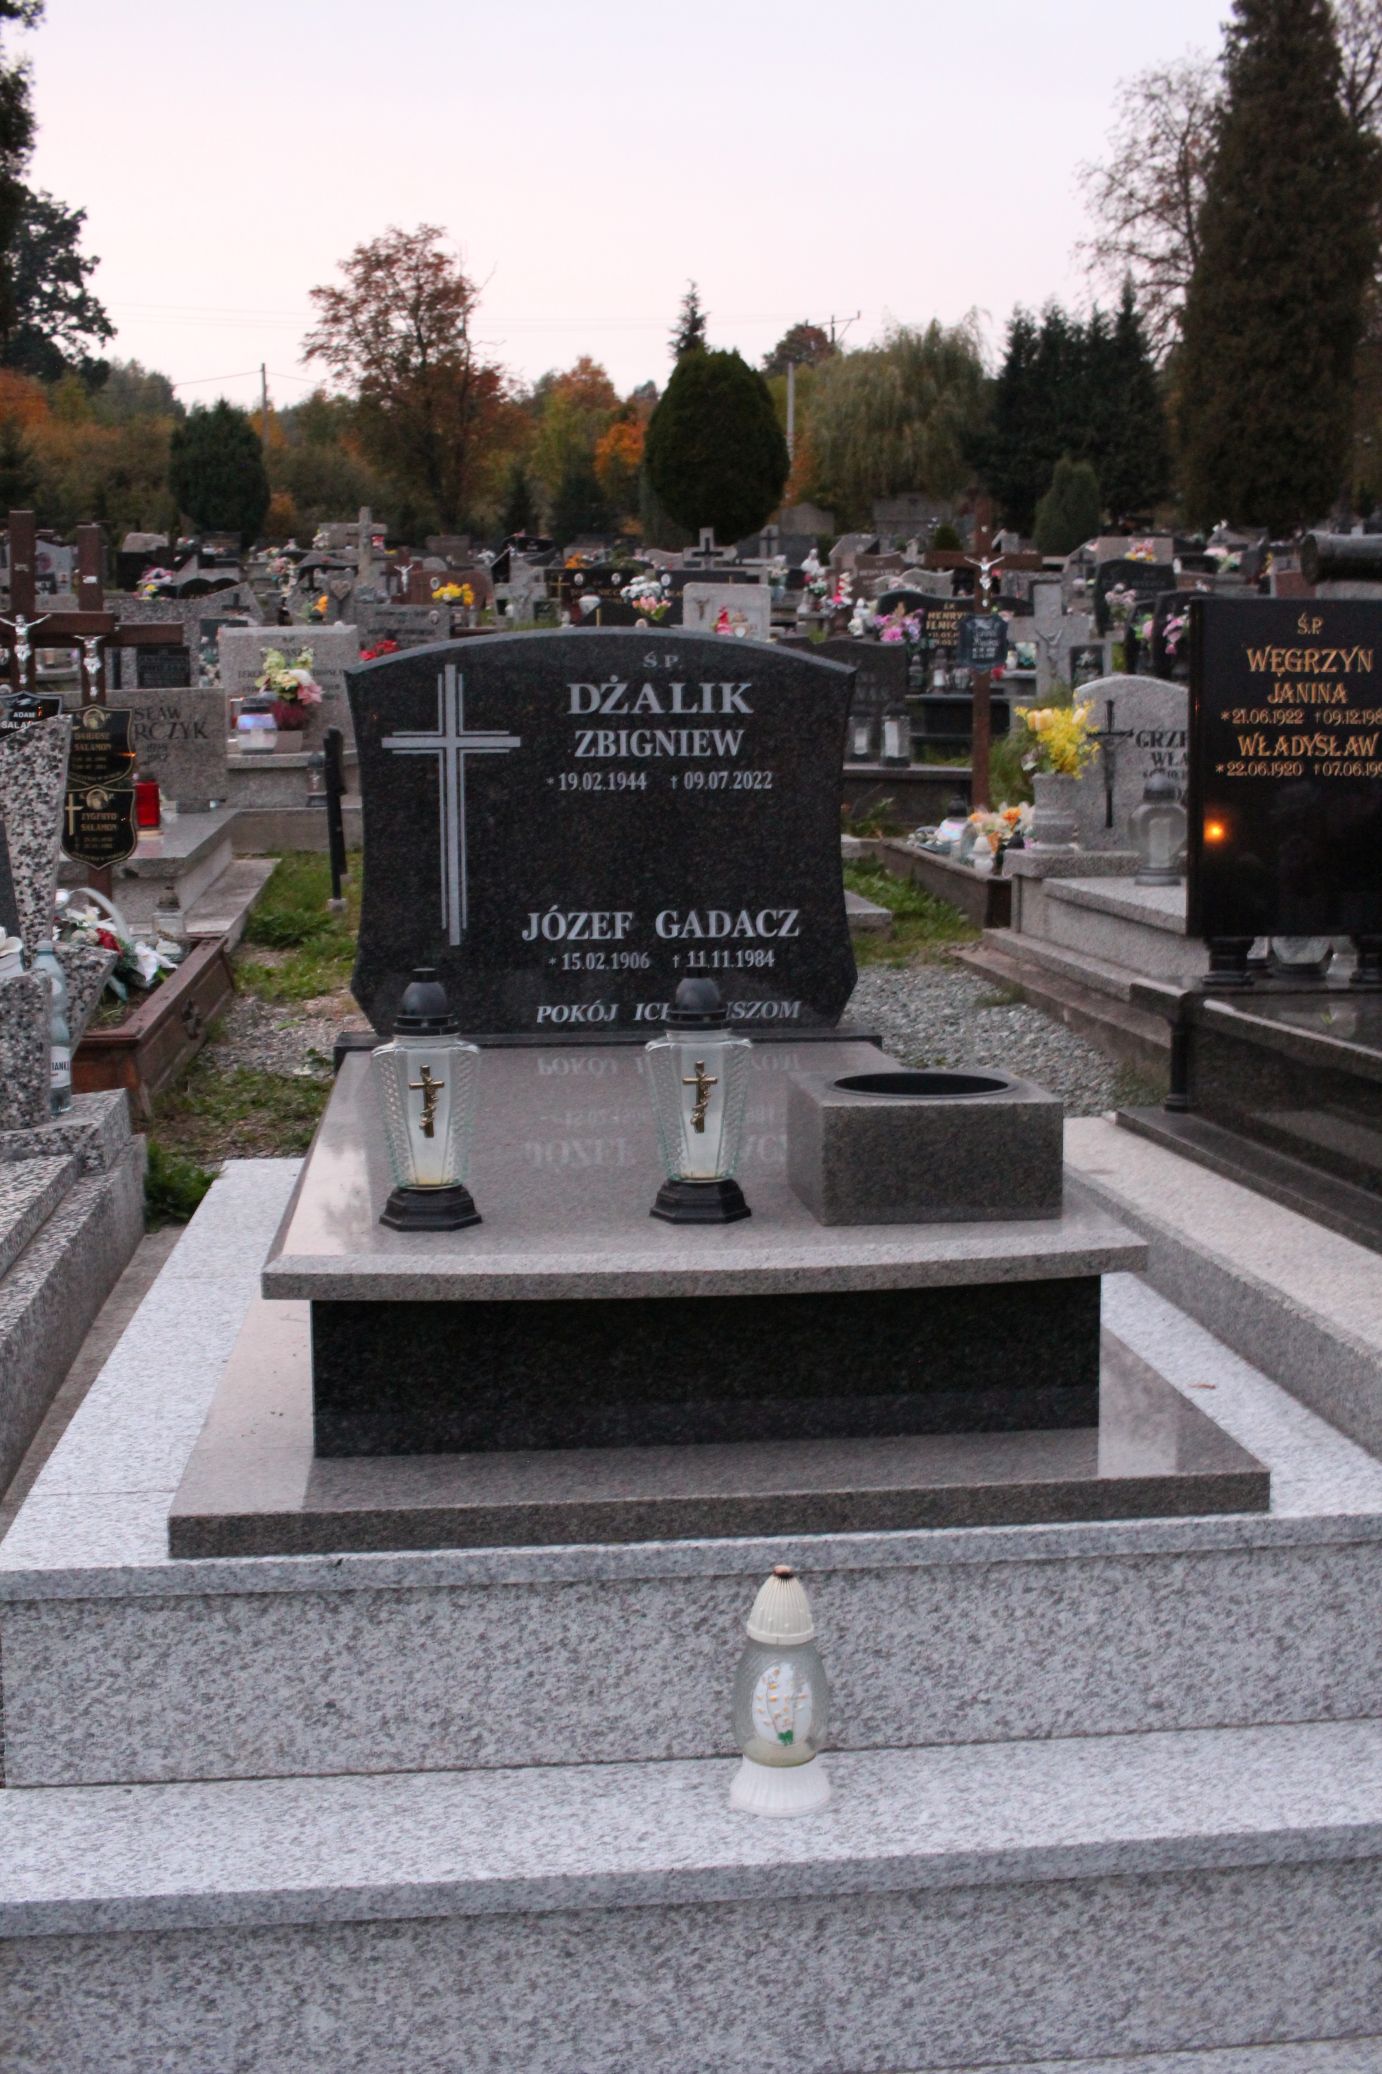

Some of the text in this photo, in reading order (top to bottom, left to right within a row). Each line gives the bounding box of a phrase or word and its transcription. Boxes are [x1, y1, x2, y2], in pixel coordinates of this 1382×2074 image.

[926, 620, 959, 630] ILNIC
[1246, 645, 1374, 677] WĘGRZYN
[567, 674, 755, 715] DŻALIK
[1267, 682, 1348, 704] JANINA
[13, 711, 36, 719] ADAM
[1231, 708, 1382, 726] 21.06.1922 09.12.198
[135, 721, 209, 740] RCZYK
[574, 729, 746, 758] ZBIGNIEW
[1238, 732, 1379, 757] WŁADYSŁAW
[1226, 760, 1382, 778] 22.06.1920 07.06.199
[558, 770, 774, 791] 19.02.1944 09.07.2022
[522, 904, 800, 941] JÓZEF GADACZ
[562, 949, 776, 970] 15.02.1906 11.11.1984
[536, 1000, 619, 1024] POKÓJ
[726, 1001, 801, 1020] SZOM
